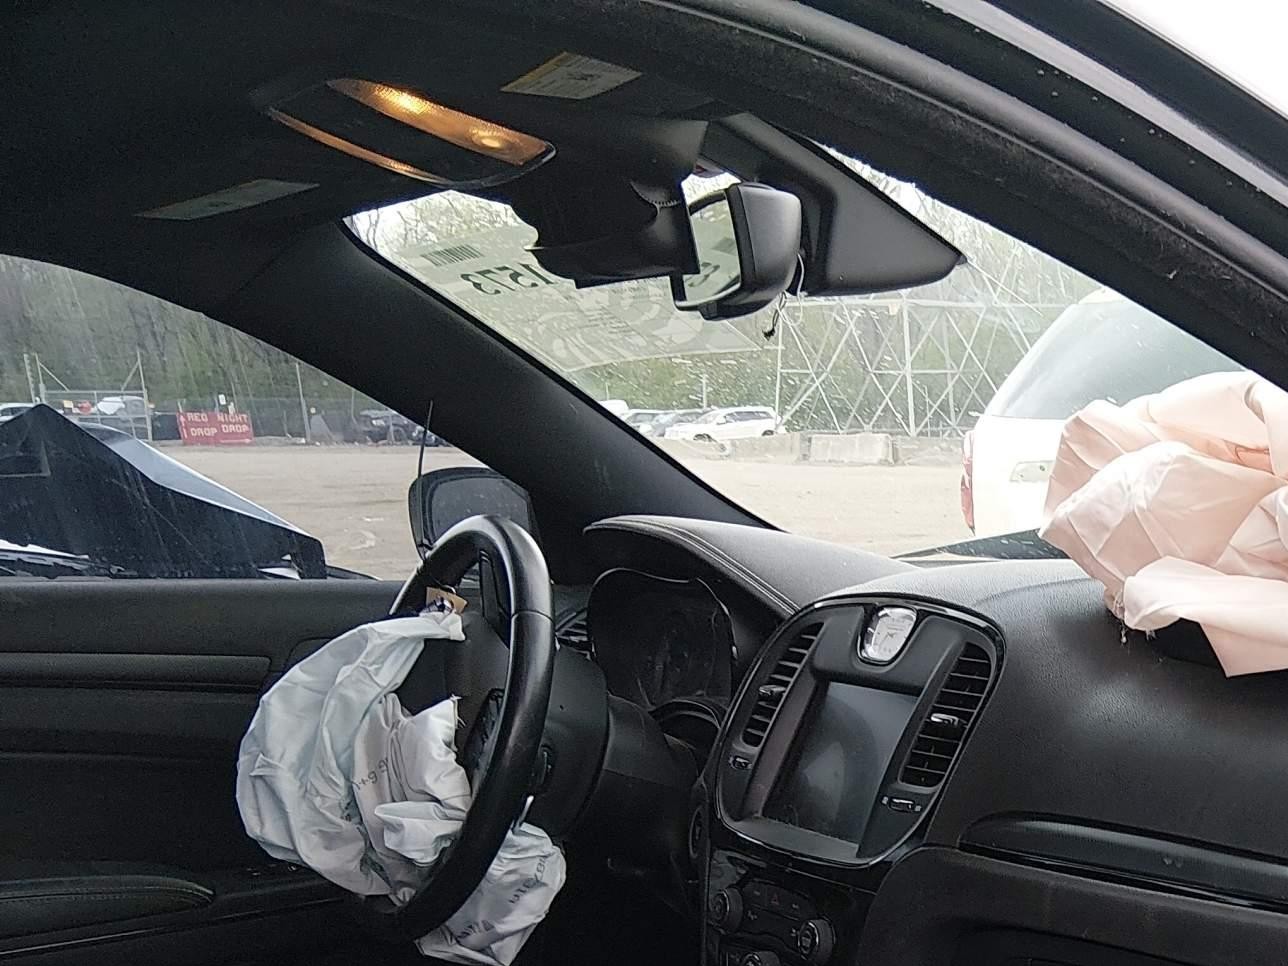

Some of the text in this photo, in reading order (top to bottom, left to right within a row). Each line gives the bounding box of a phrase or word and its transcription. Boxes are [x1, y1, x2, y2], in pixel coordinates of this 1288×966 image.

[217, 413, 248, 423] NIGHT
[190, 427, 218, 436] DROP
[221, 424, 249, 433] DROP
